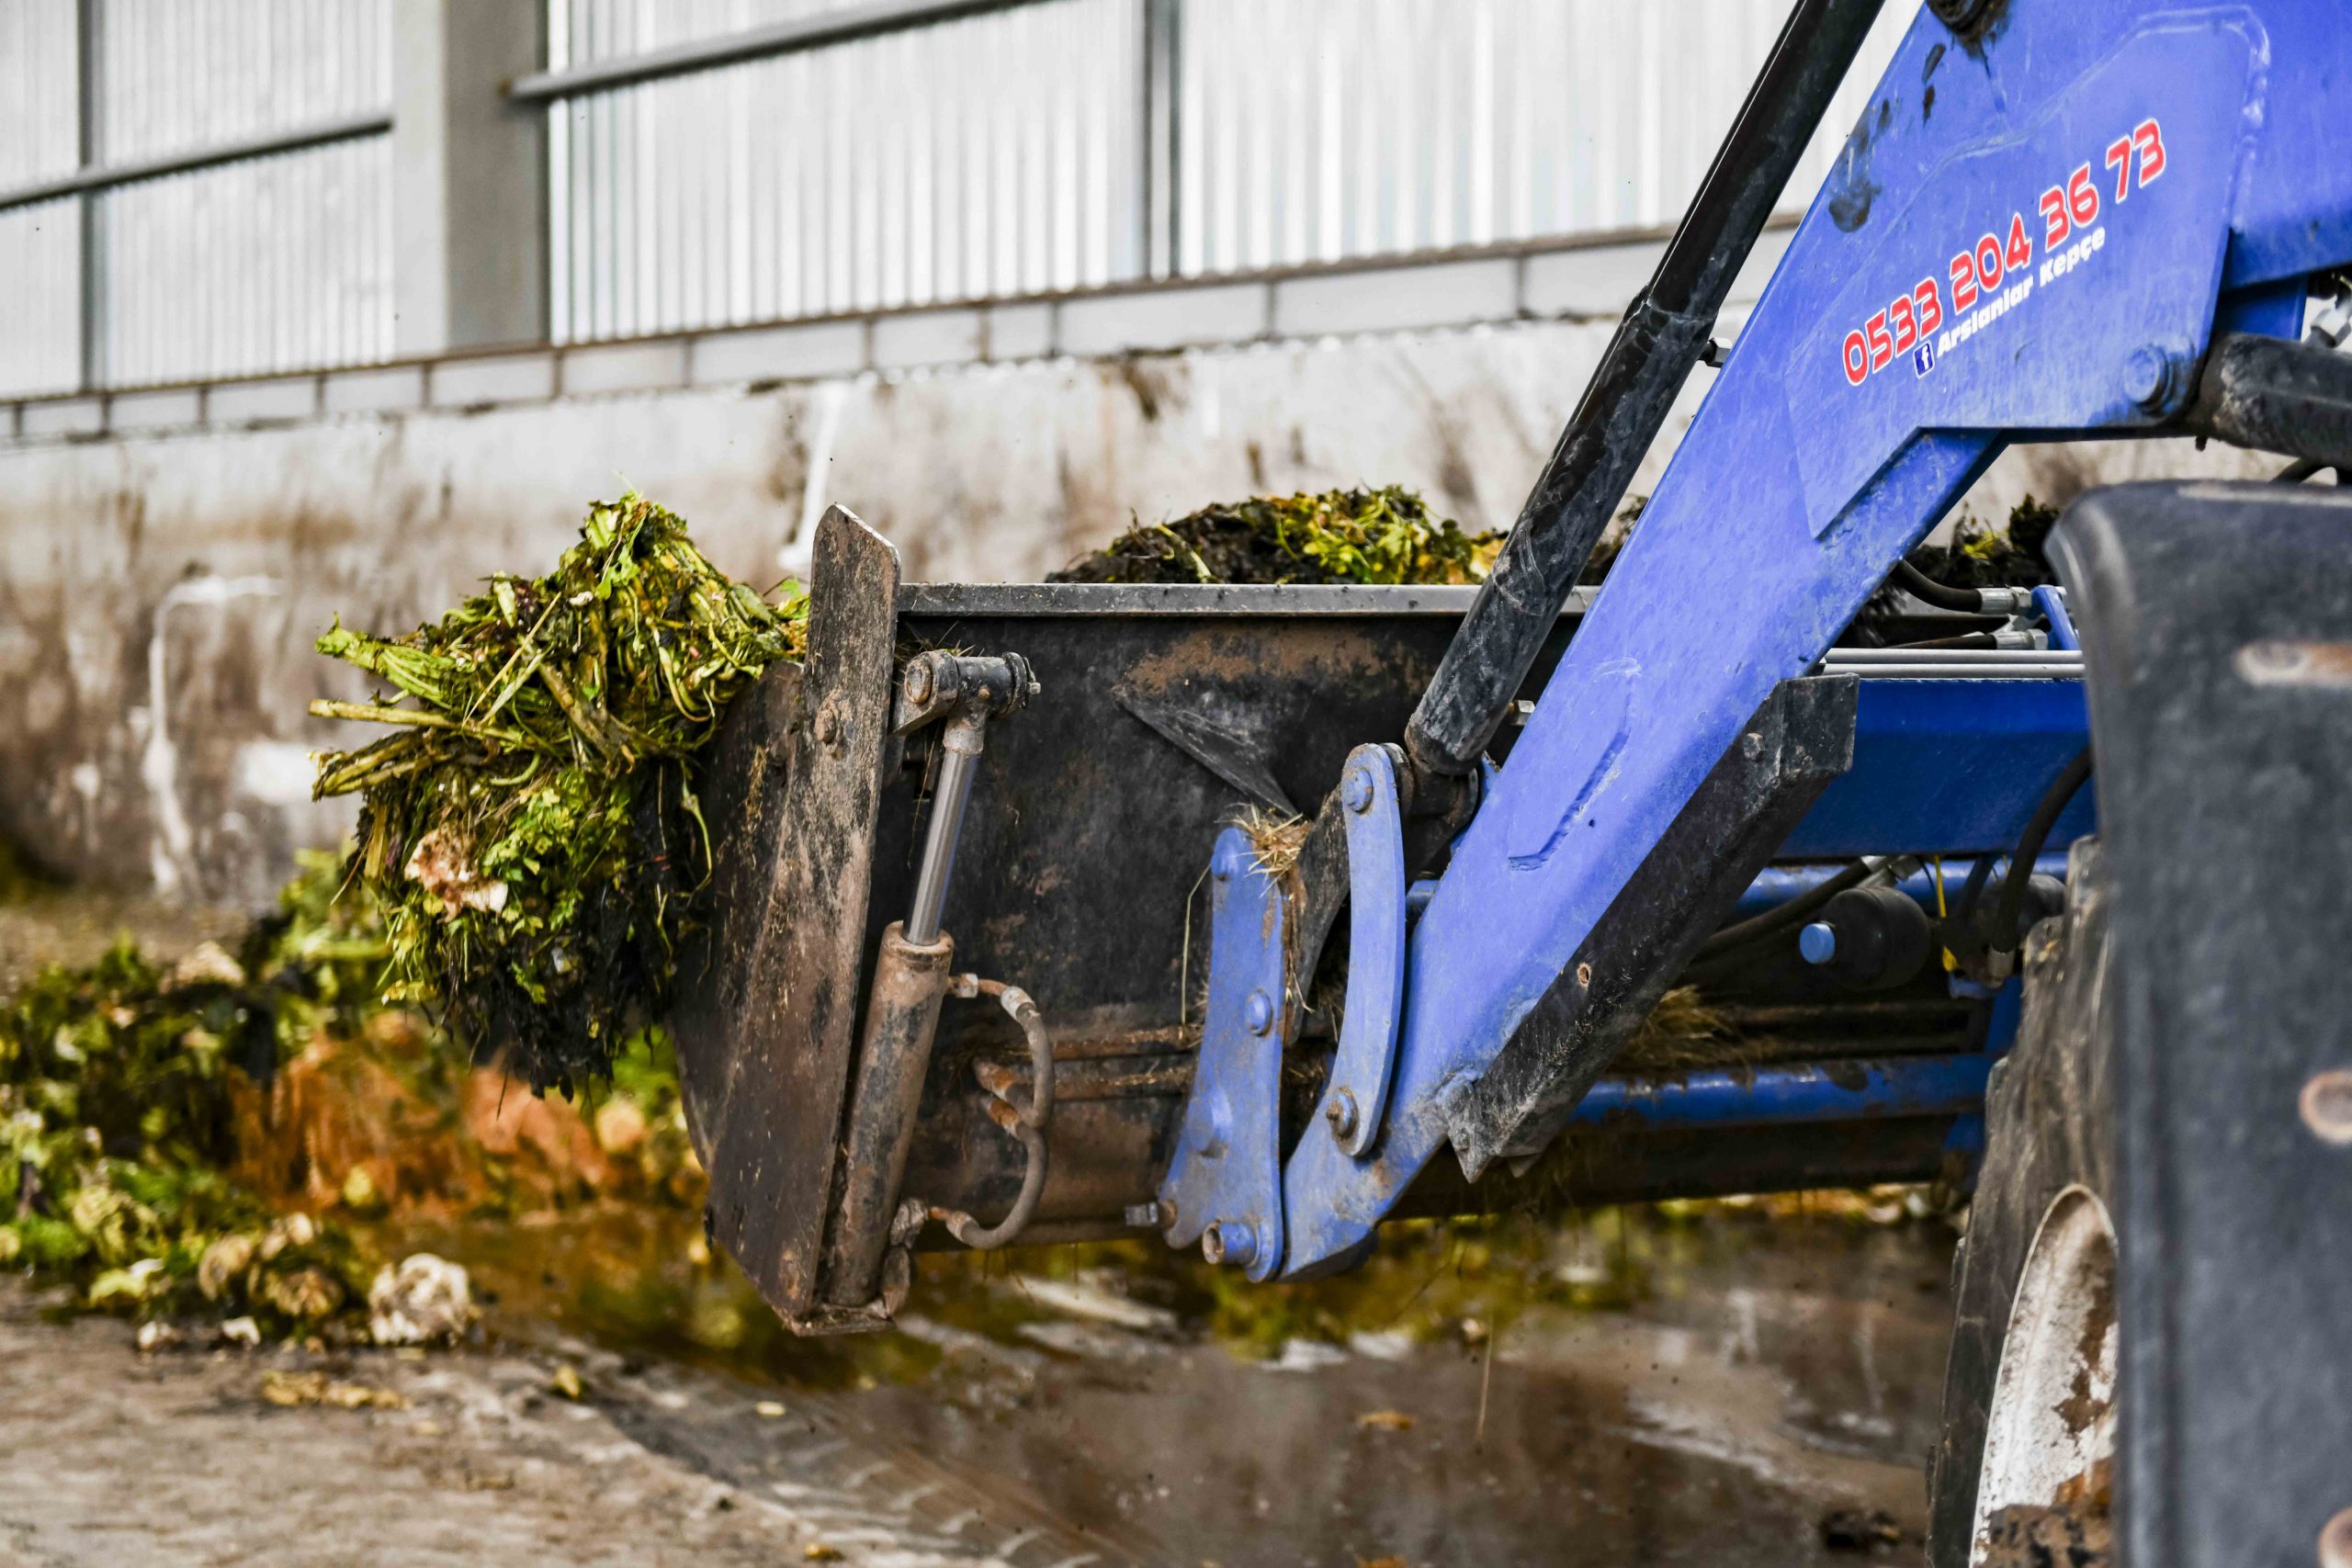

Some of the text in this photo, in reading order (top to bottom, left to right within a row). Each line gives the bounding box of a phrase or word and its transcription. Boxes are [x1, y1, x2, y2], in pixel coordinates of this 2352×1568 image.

[1842, 118, 2166, 386] 0533 204 36 73
[1937, 275, 2033, 357] Arslanlar
[2040, 227, 2105, 287] Kepçe
